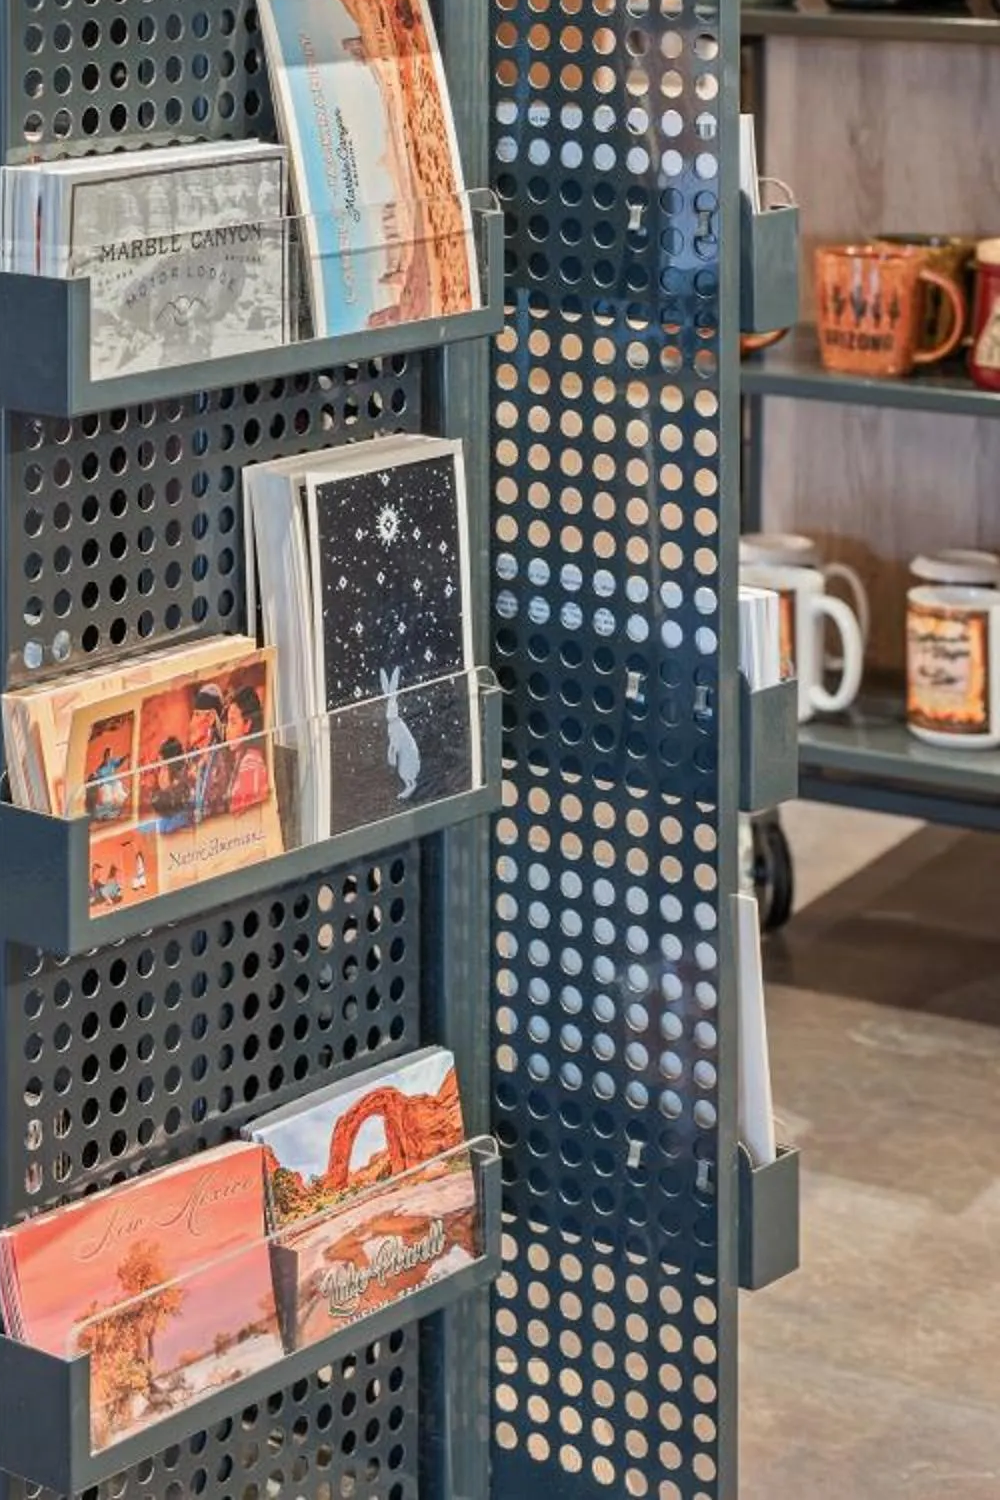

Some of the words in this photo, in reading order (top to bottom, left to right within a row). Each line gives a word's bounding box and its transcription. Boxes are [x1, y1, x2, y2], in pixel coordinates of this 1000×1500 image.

[100, 234, 182, 262] MARBLE
[191, 222, 263, 249] CANYON
[126, 267, 180, 307] MOTOR
[155, 1171, 254, 1237] Mexico
